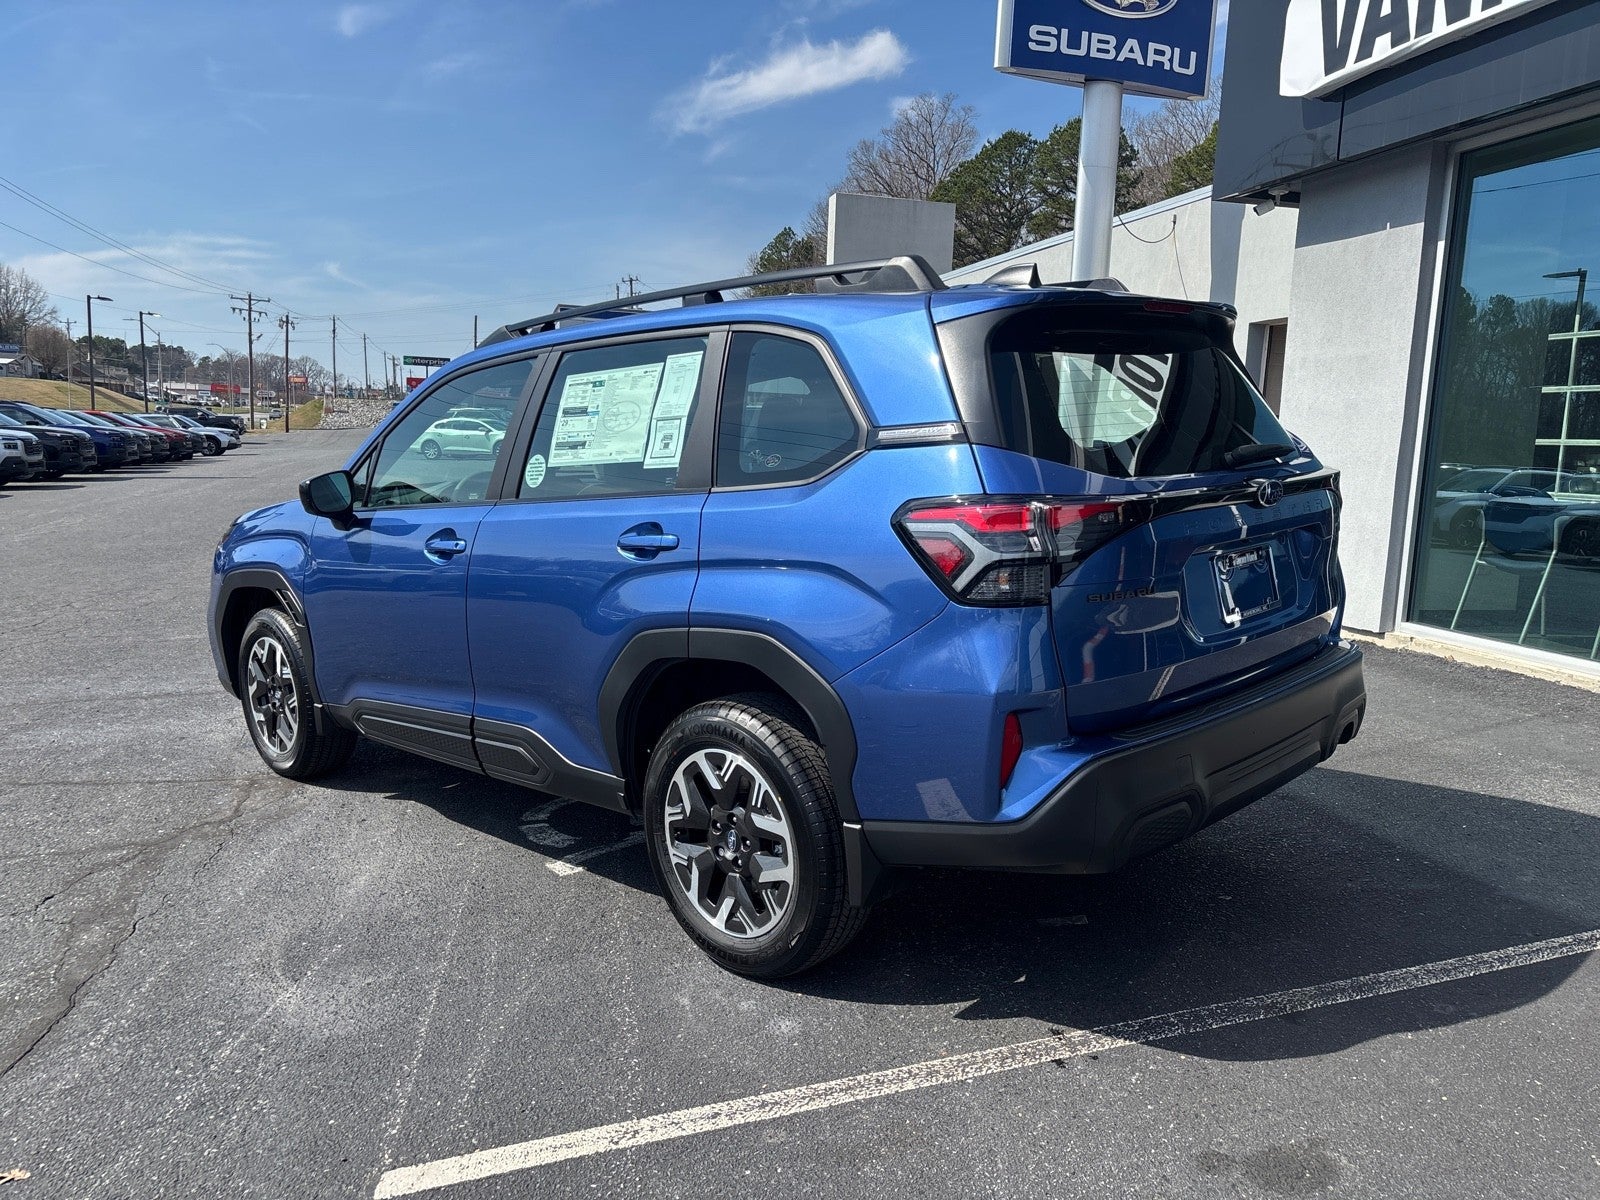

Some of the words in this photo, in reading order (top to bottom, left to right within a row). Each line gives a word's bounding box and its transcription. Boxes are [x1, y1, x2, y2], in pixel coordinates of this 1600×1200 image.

[1028, 24, 1197, 76] SUBARU
[1319, 0, 1510, 77] VA
[1087, 586, 1156, 603] SUBARU
[688, 723, 746, 747] YOKOHAMA
